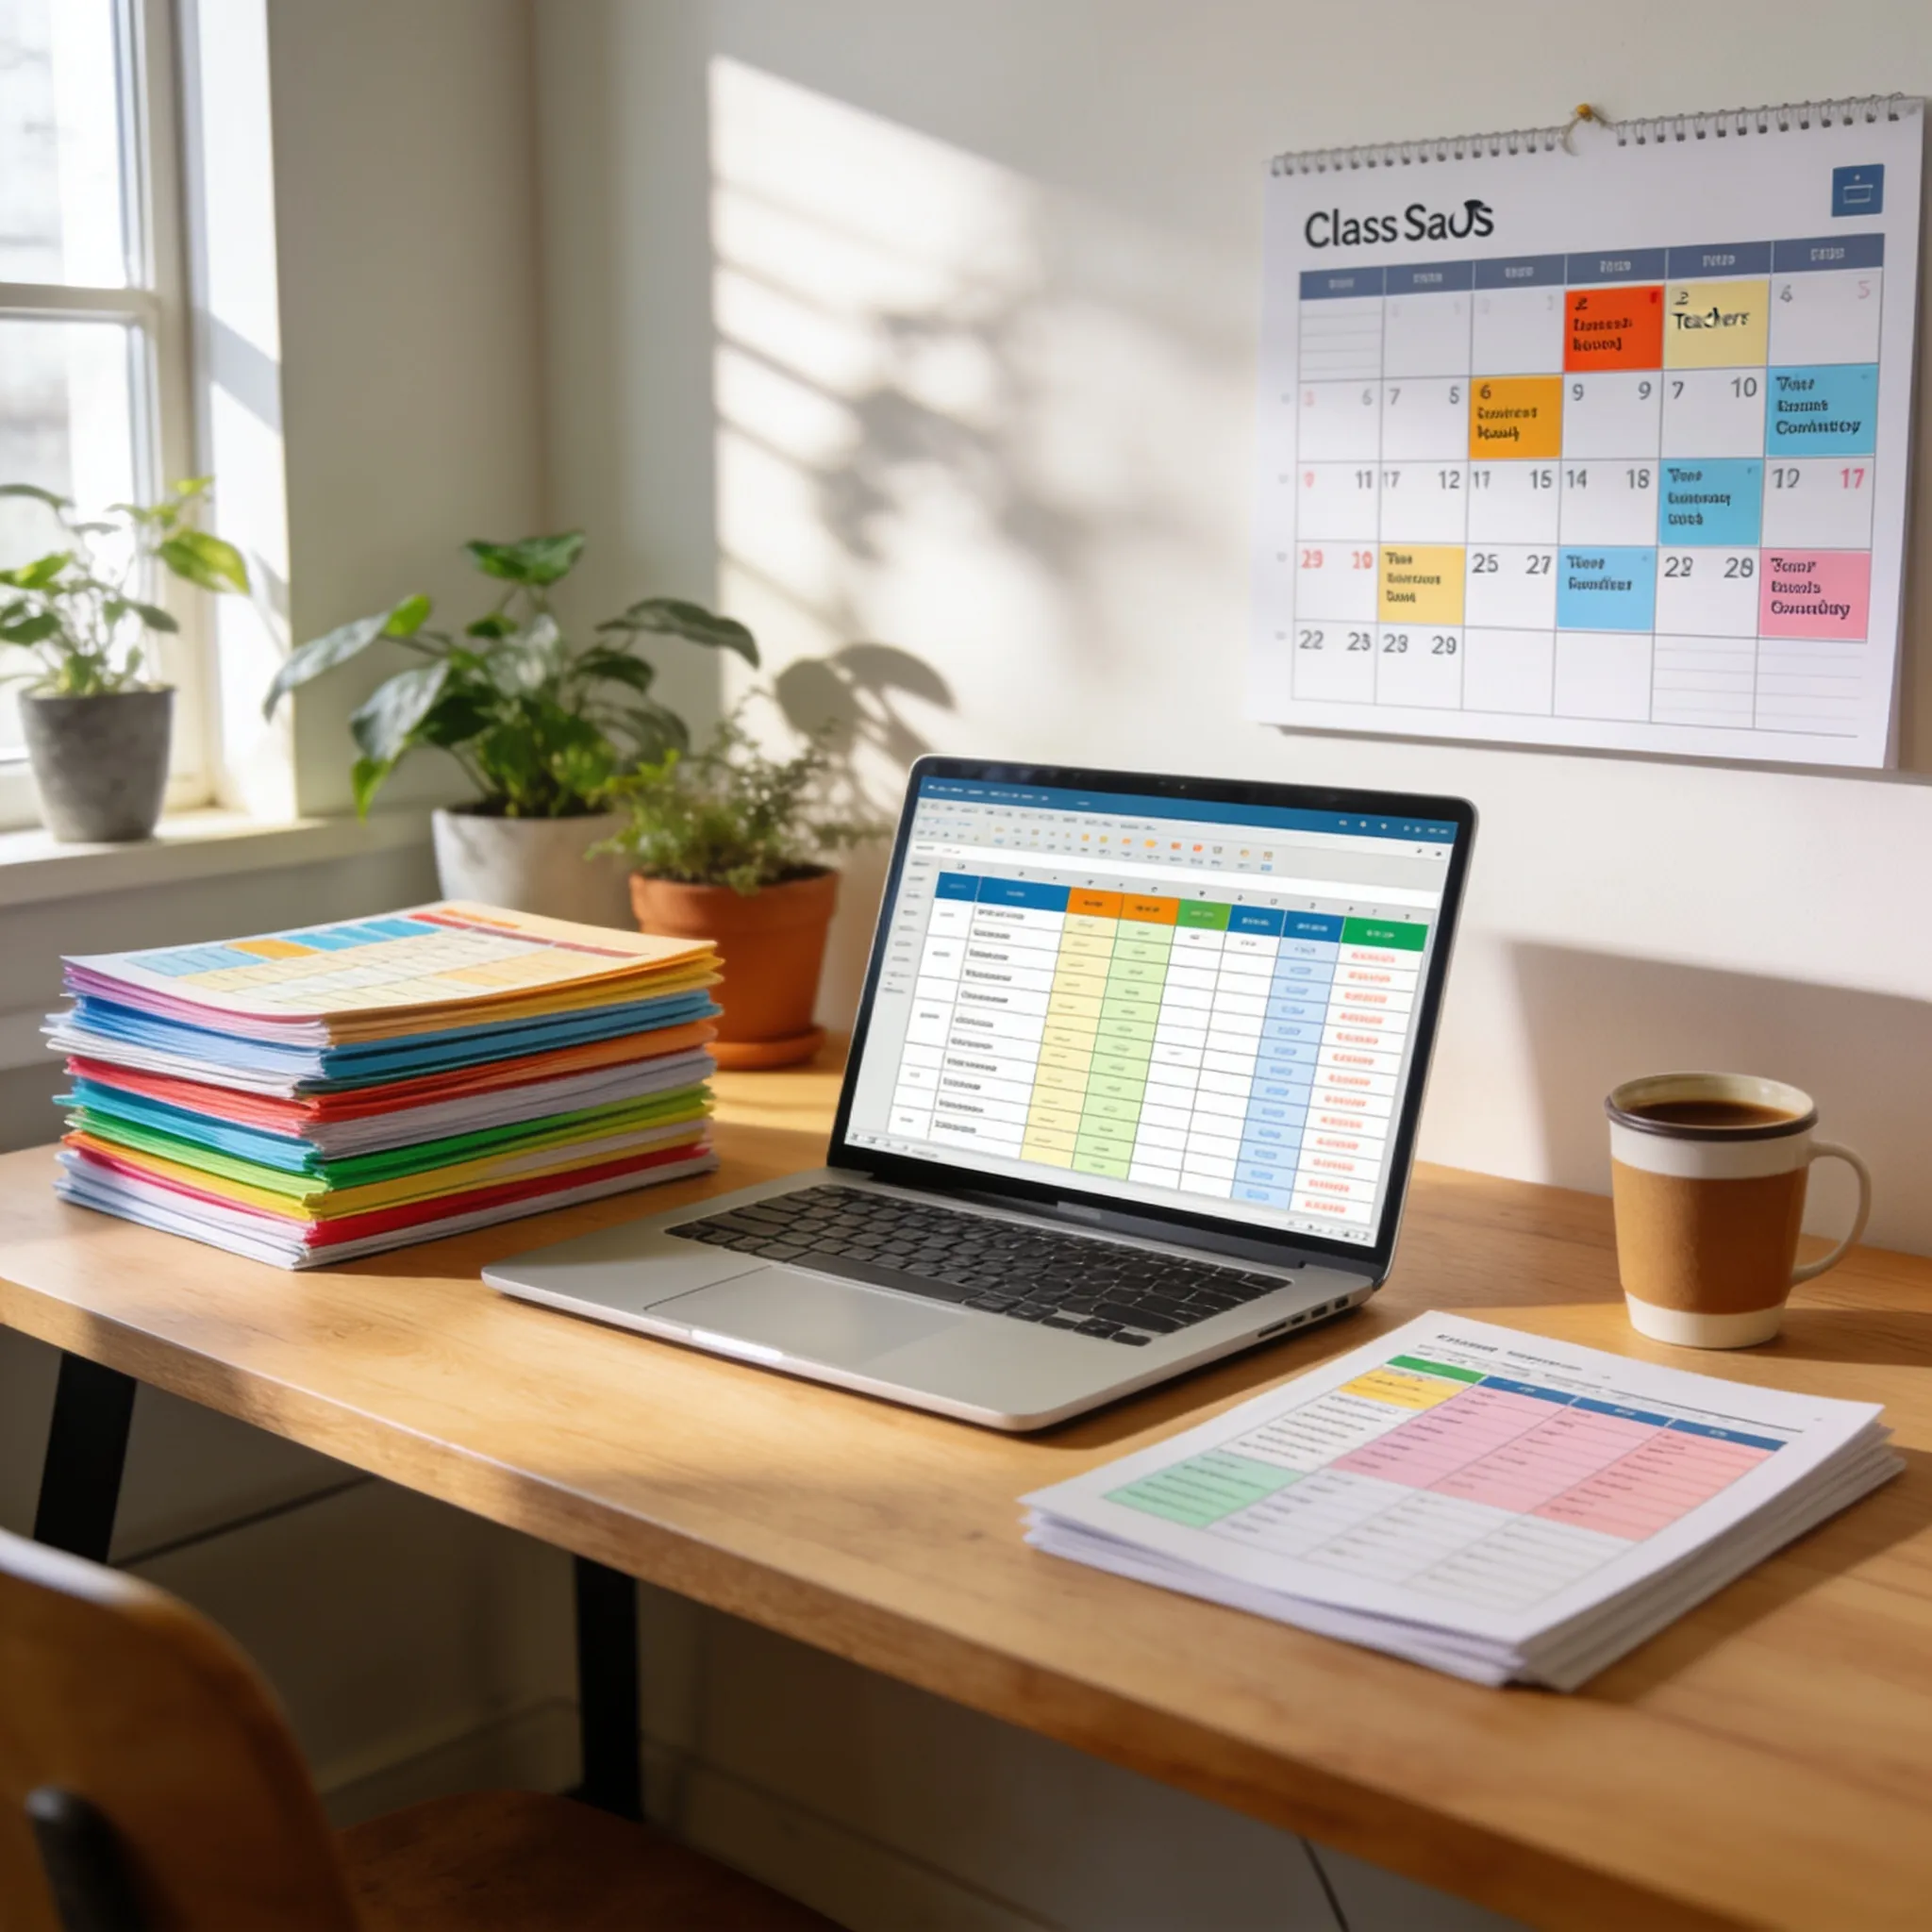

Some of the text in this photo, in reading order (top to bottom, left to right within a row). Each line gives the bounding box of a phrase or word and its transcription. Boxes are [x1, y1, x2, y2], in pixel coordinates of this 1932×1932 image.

[1305, 208, 1398, 249] Class
[1389, 388, 1401, 406] 7
[1572, 383, 1585, 402] 9
[1638, 380, 1652, 401] 9
[1672, 380, 1684, 400] 7
[1730, 376, 1757, 398] 10
[1356, 470, 1373, 490] 11
[1439, 470, 1460, 490] 12
[1566, 469, 1588, 489] 14
[1626, 468, 1650, 489] 18
[1840, 468, 1865, 489] 17
[1473, 553, 1499, 575] 25
[1525, 555, 1552, 575] 27
[1299, 629, 1324, 650] 22
